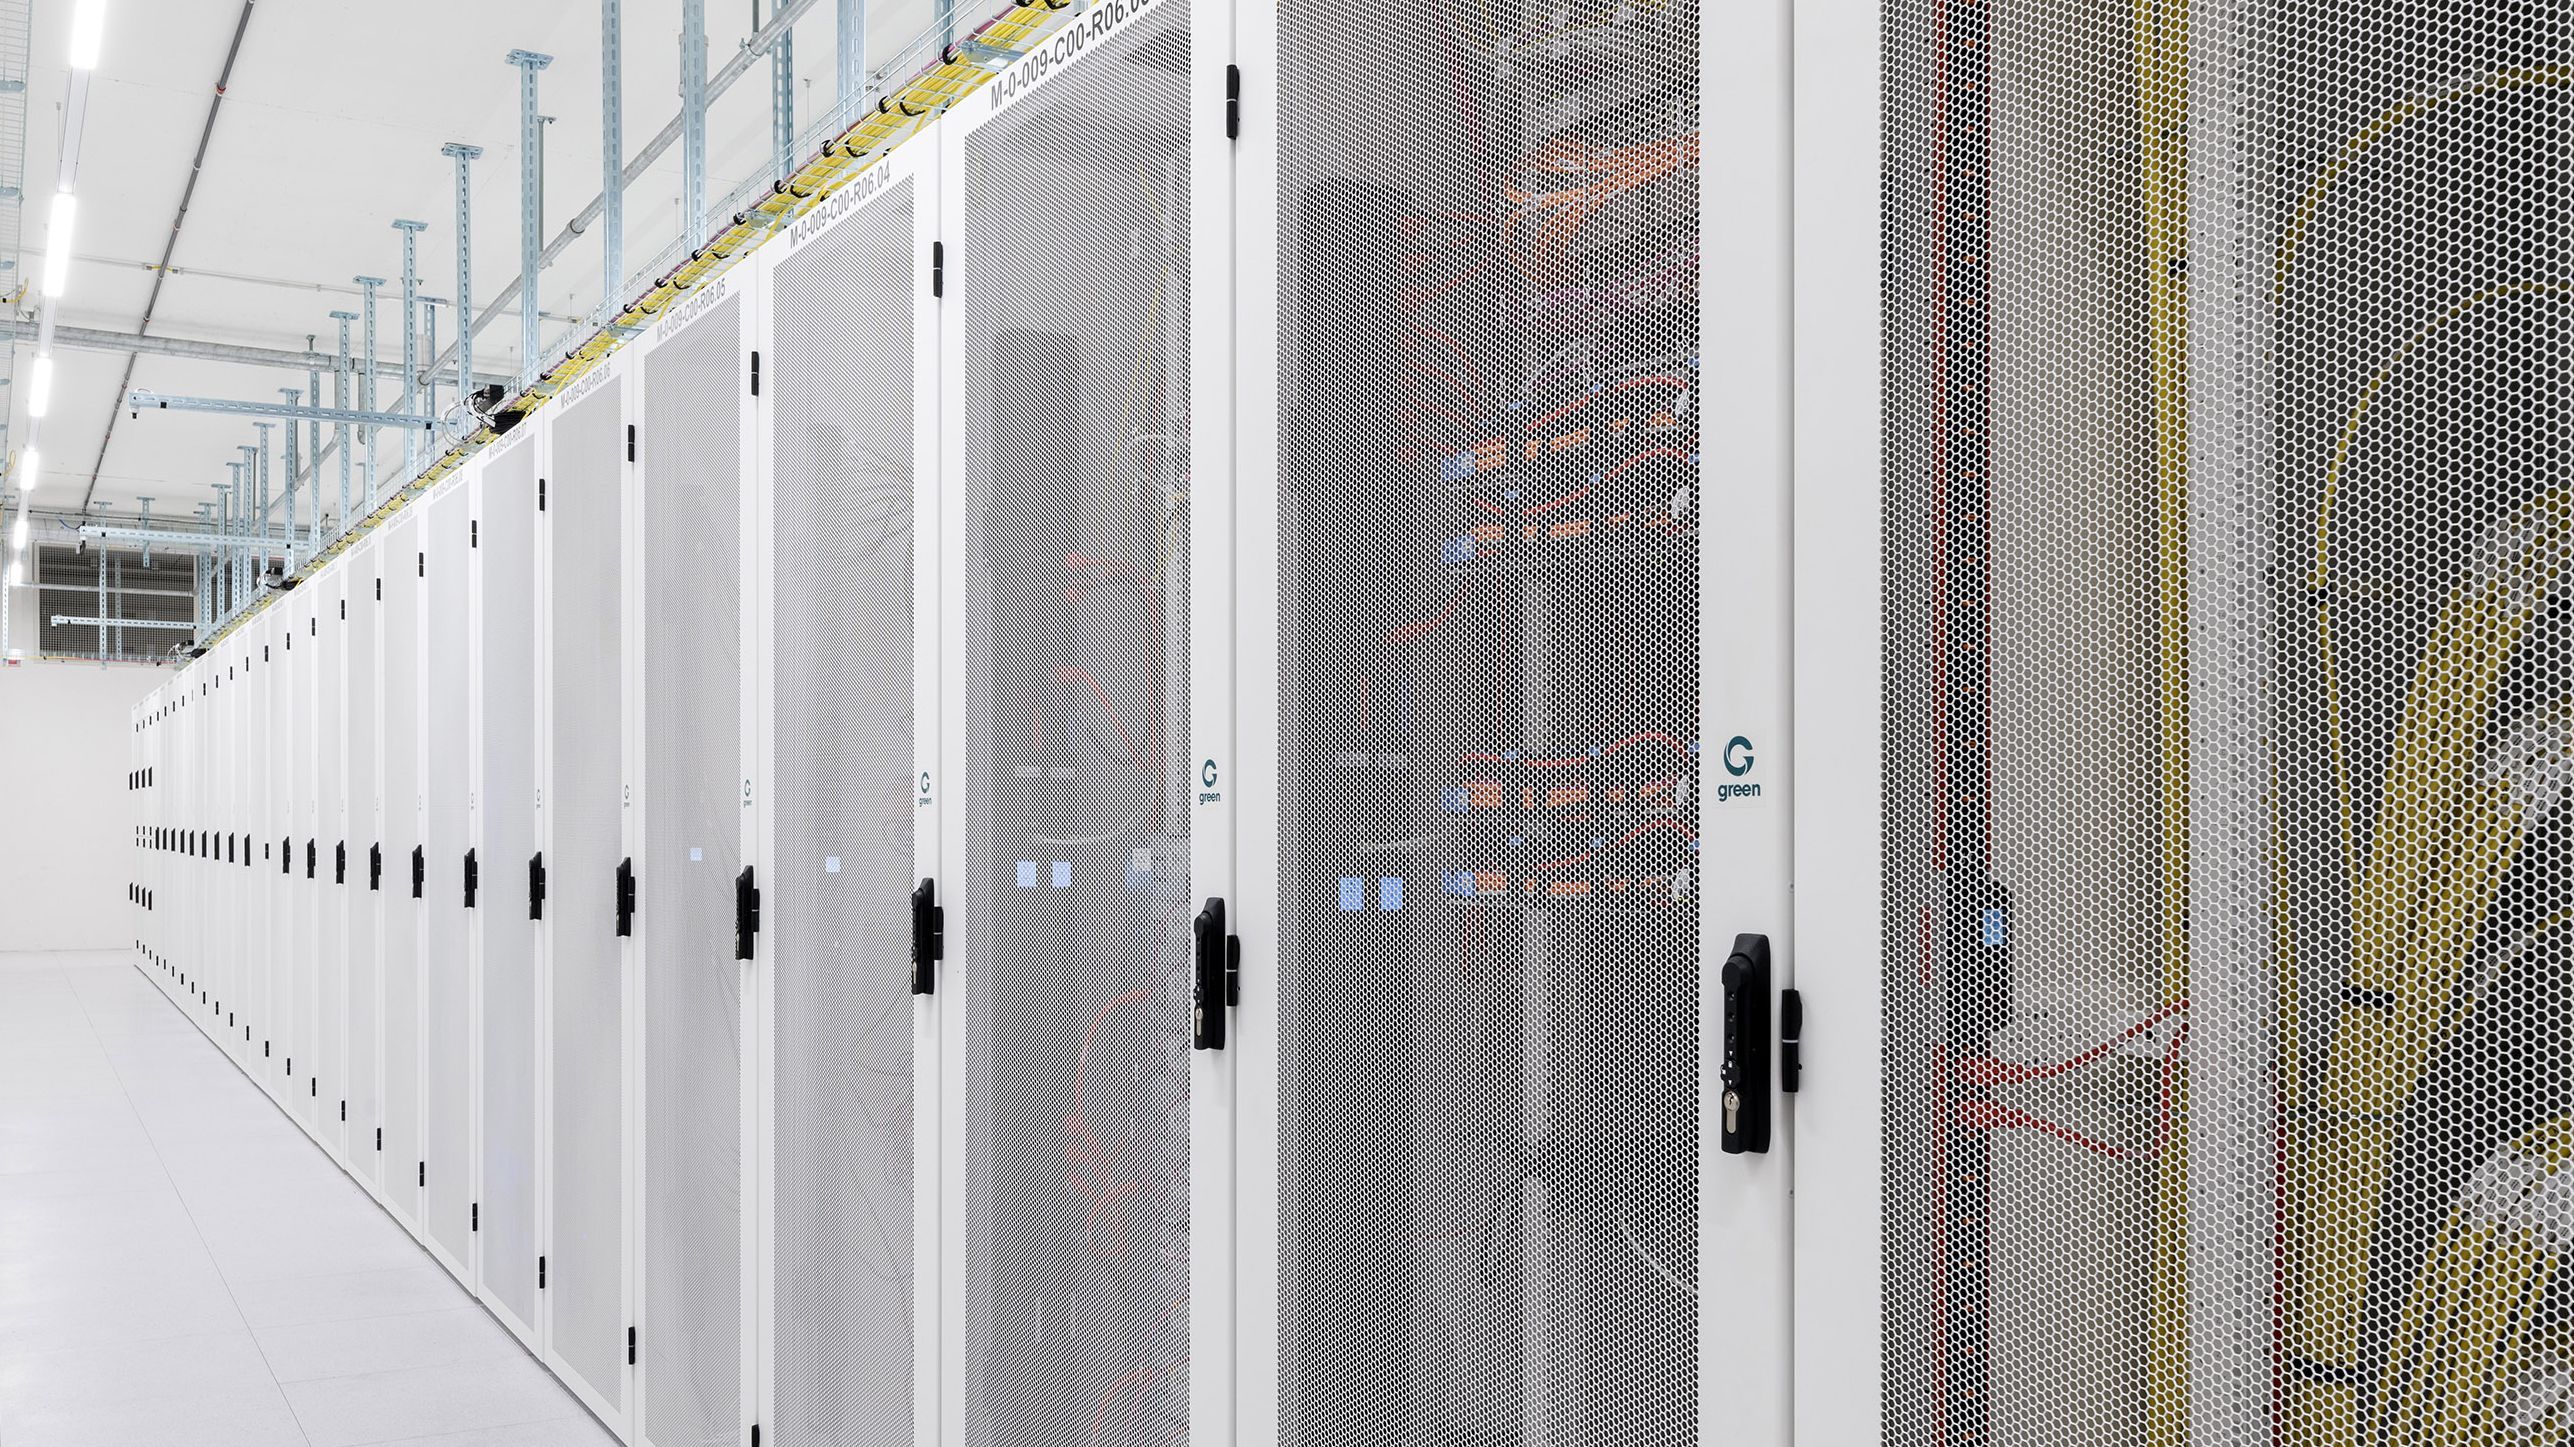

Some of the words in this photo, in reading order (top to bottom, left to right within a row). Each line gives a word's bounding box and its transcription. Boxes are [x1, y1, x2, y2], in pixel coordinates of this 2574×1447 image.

[990, 0, 1150, 111] M-0-009-C00-R06.
[789, 159, 891, 249] M-0-009-C00-R06.04
[656, 277, 726, 342] M-0-009-C00-R06.05
[1199, 792, 1221, 805] green
[1717, 783, 1761, 802] green
